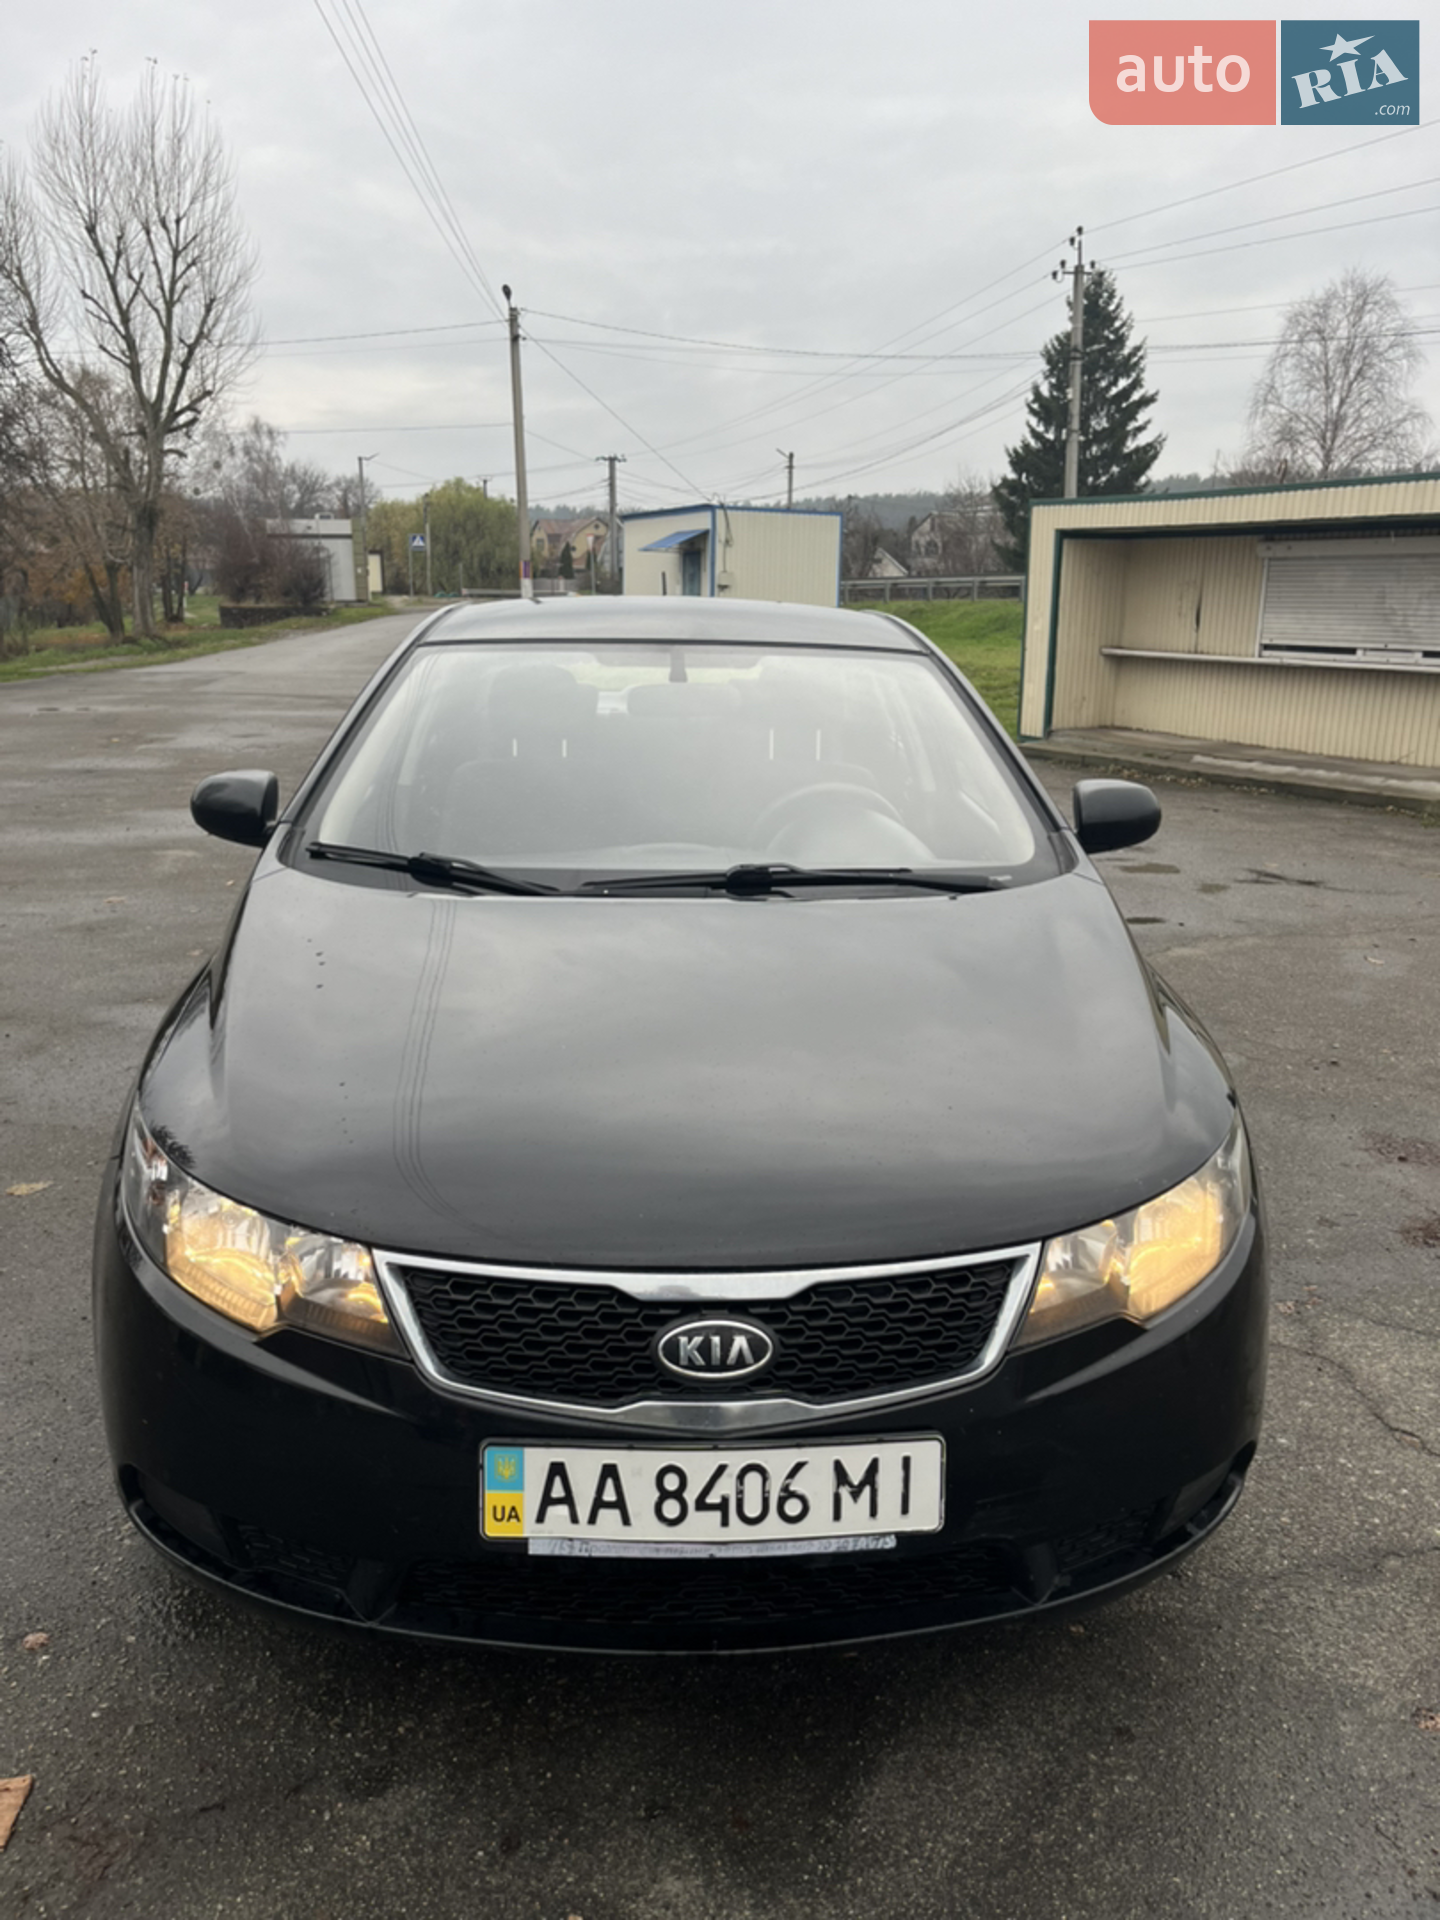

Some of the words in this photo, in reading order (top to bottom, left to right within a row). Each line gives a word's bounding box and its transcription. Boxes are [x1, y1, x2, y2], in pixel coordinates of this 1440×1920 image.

[678, 1334, 755, 1366] KIA
[535, 1461, 632, 1526] AA
[654, 1461, 811, 1527] 8406
[832, 1455, 911, 1522] MI
[493, 1505, 520, 1523] UA
